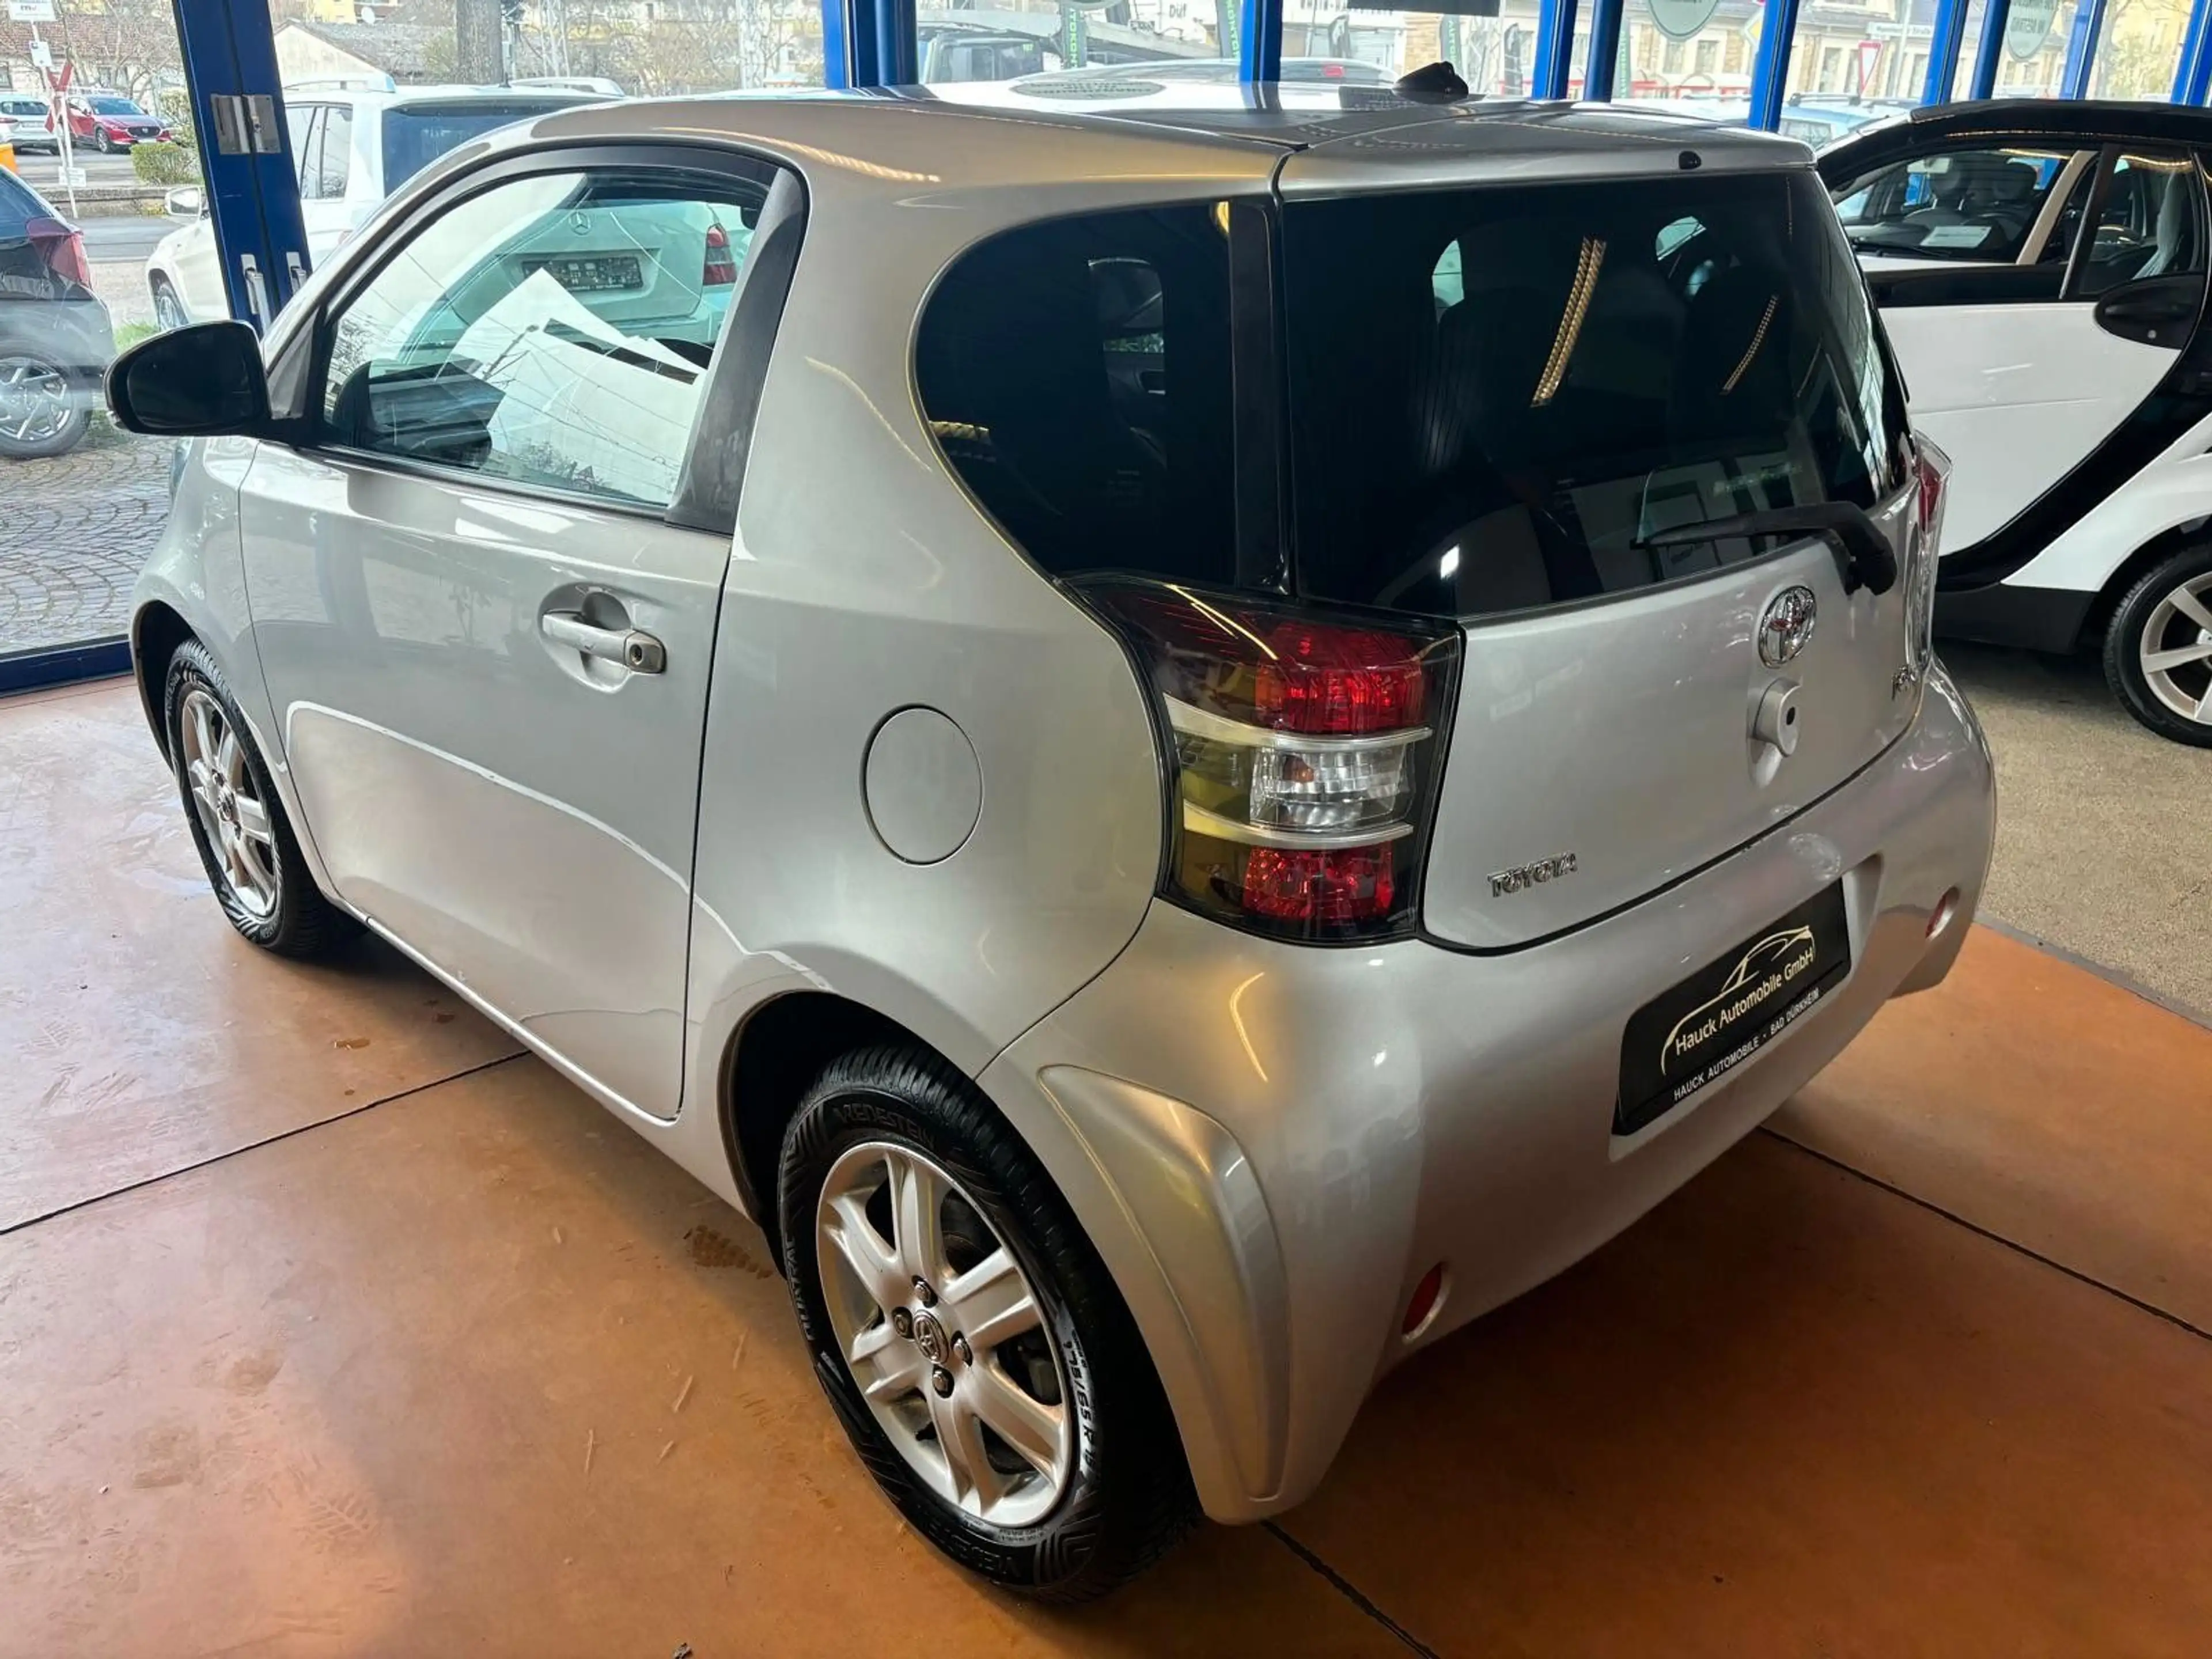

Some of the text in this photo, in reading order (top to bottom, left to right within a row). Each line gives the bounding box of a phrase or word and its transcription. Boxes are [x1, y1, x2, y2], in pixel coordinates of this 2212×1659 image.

[1487, 850, 1578, 897] TOYOTA
[1675, 946, 1814, 1056] Hauck Automobile GmbH
[1673, 1073, 1705, 1101] HAUCK
[1707, 1036, 1759, 1079] AUTOMOBILE
[1770, 1017, 1784, 1035] BAD
